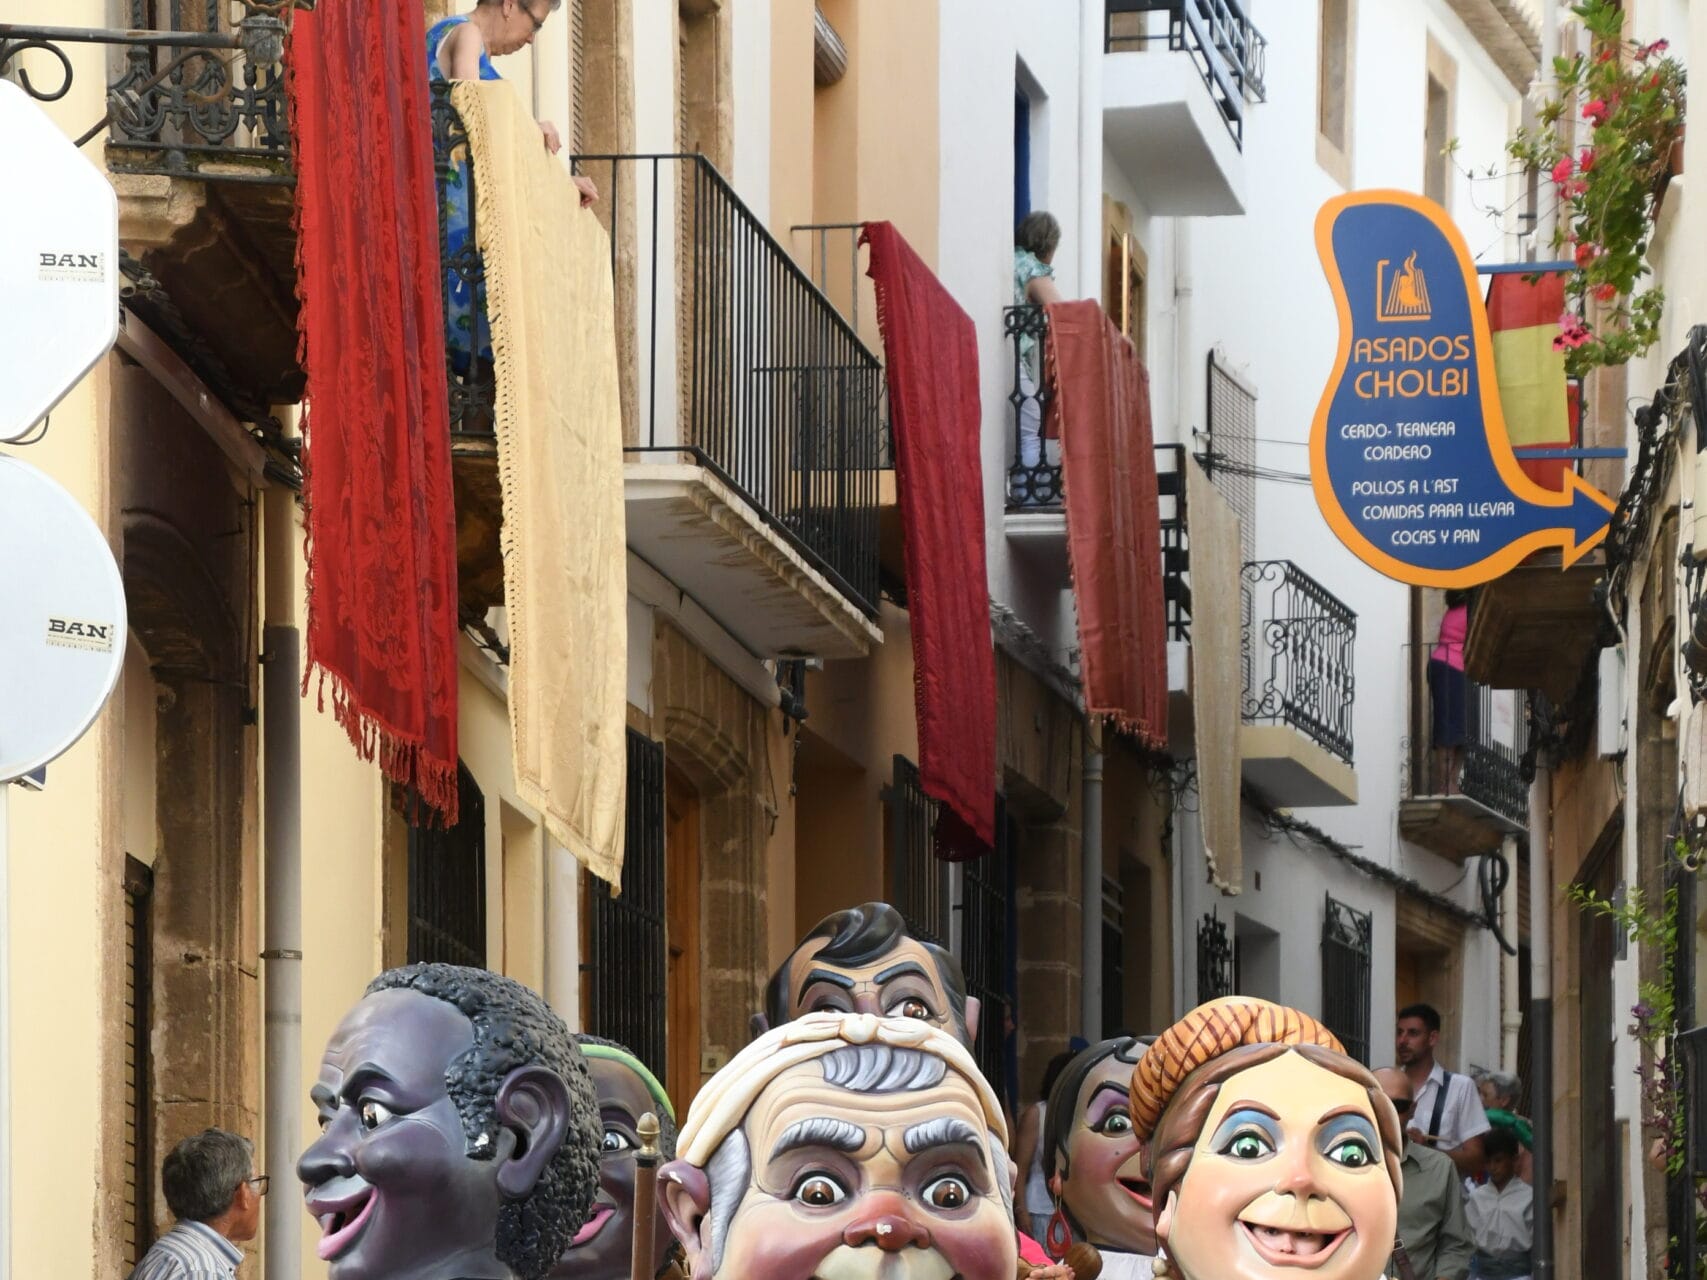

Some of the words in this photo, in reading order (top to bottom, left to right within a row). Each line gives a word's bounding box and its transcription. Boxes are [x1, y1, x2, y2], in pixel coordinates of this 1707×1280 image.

[39, 253, 98, 268] BAN
[1353, 335, 1470, 364] ASADOS
[1354, 367, 1469, 399] CHOLBI
[1396, 421, 1456, 437] TERNERA
[1363, 444, 1432, 461] CORDERO
[1352, 480, 1405, 496] POLLOS
[1409, 480, 1419, 494] A
[1362, 504, 1425, 520] COMIDAS
[1429, 503, 1464, 518] PARA
[1468, 501, 1515, 517] LLEVAR
[1391, 529, 1436, 545] COCAS
[1440, 529, 1449, 544] Y
[1453, 529, 1480, 543] PAN
[48, 618, 107, 639] BAN
